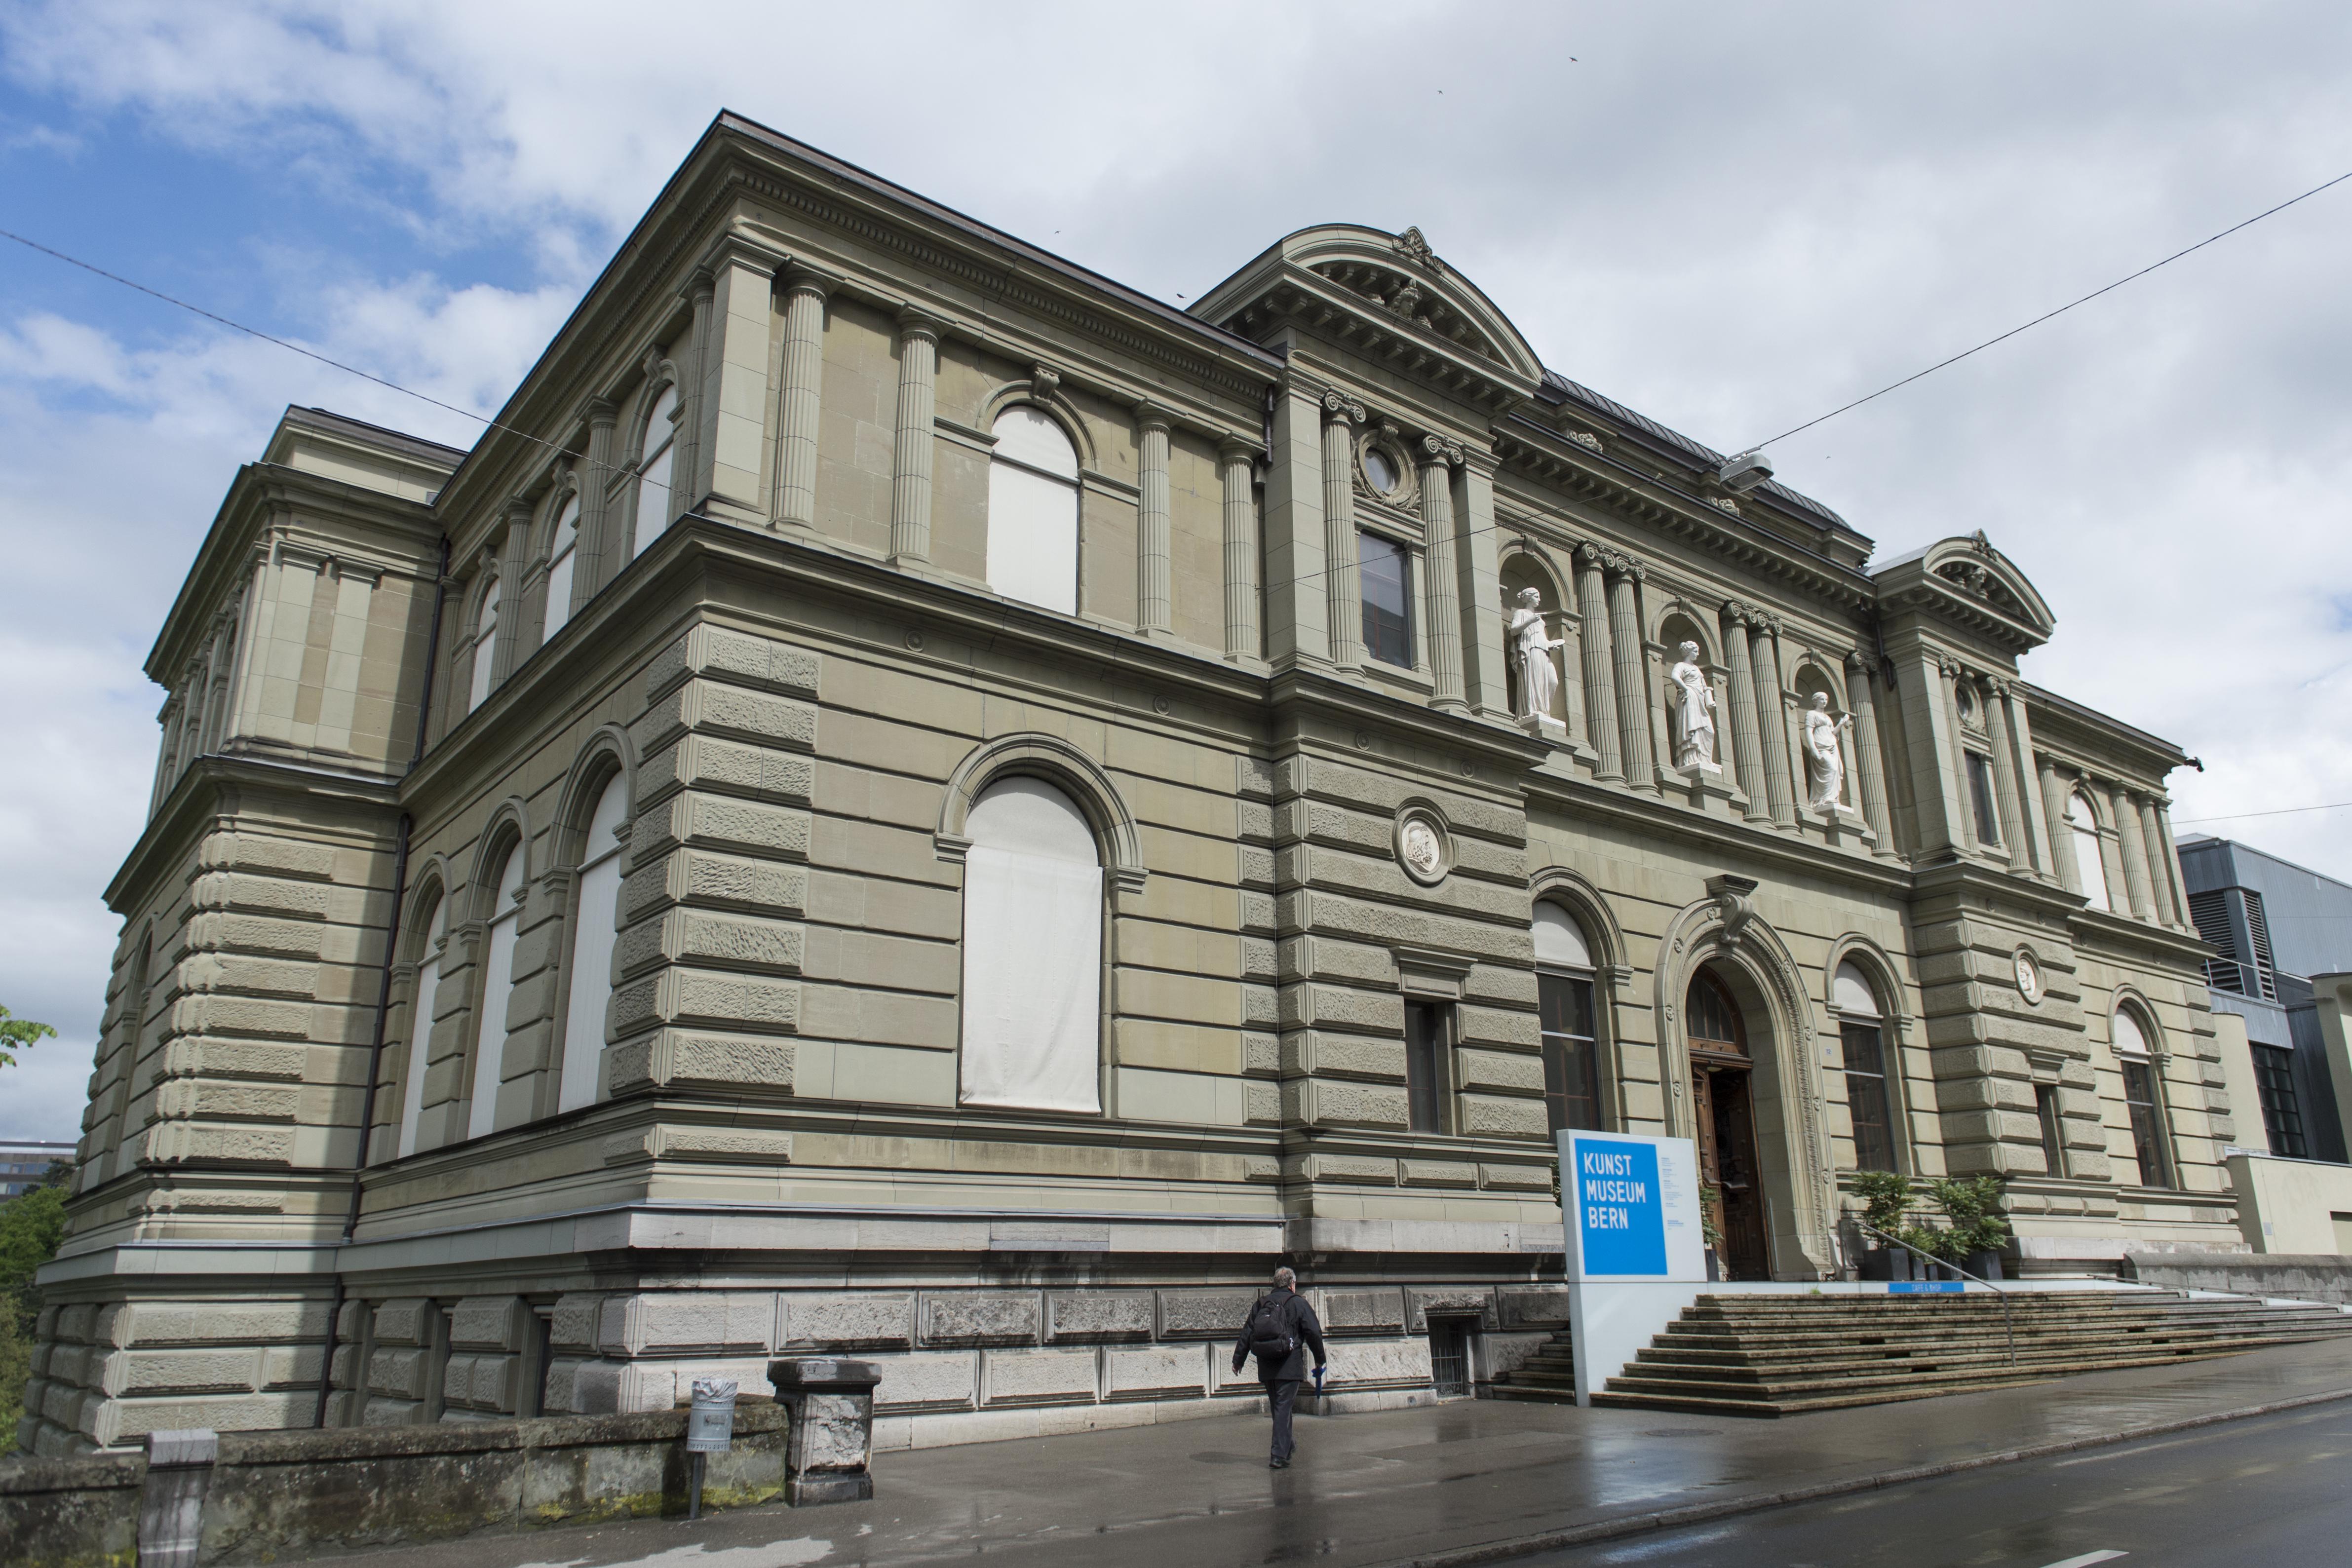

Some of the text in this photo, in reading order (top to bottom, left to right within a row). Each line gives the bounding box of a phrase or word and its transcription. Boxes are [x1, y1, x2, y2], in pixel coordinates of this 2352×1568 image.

[1584, 1152, 1631, 1176] KUNST
[1586, 1180, 1646, 1203] MUSEUM
[1588, 1207, 1628, 1229] BERN
